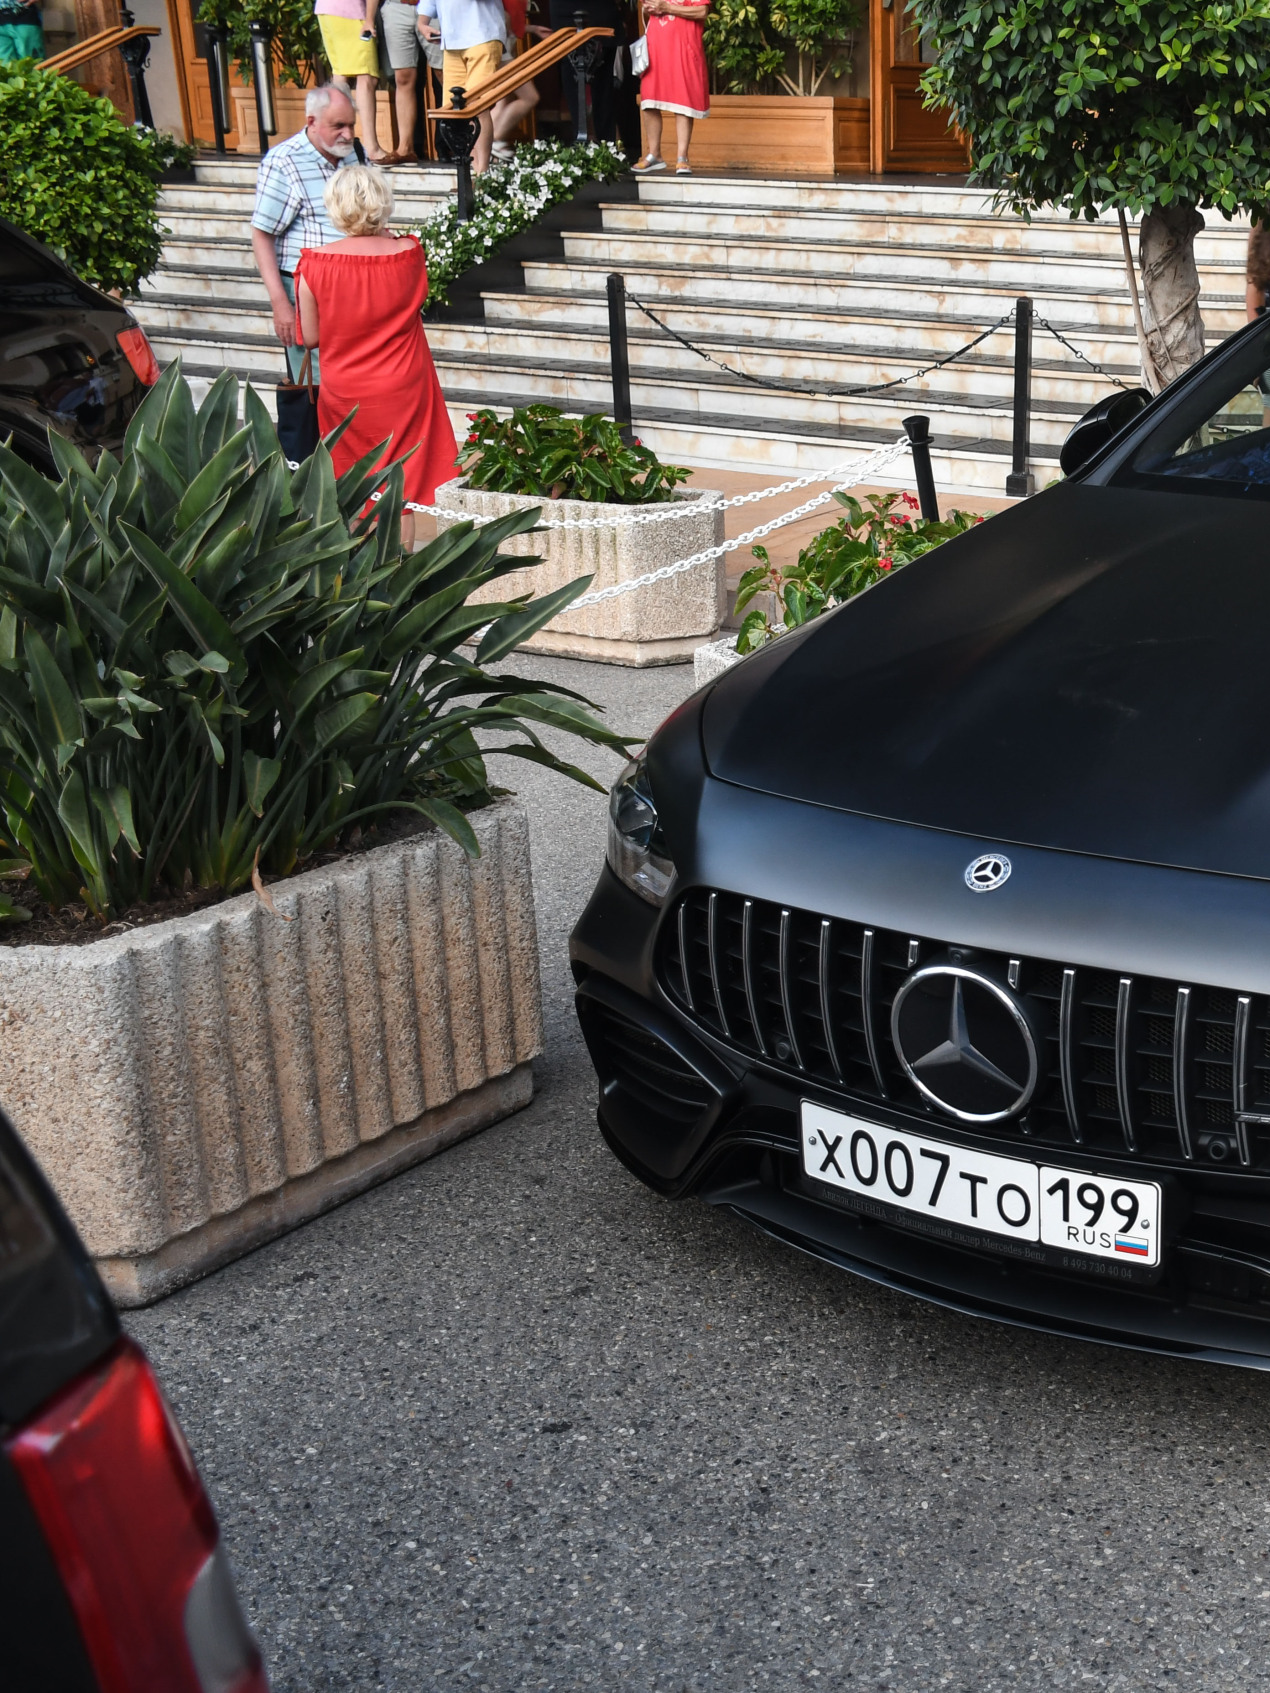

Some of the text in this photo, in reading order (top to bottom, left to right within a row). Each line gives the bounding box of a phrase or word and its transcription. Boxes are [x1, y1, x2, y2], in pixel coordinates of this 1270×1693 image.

[1046, 1177, 1140, 1234] 199
[850, 1198, 887, 1220] ЛЕГЕНДА
[982, 1236, 1047, 1262] Mercedes-Benz
[1070, 1257, 1087, 1271] 495
[1089, 1261, 1105, 1274] 730
[1108, 1264, 1119, 1277] 40
[1121, 1267, 1133, 1280] 04
[1066, 1225, 1112, 1249] RUS
